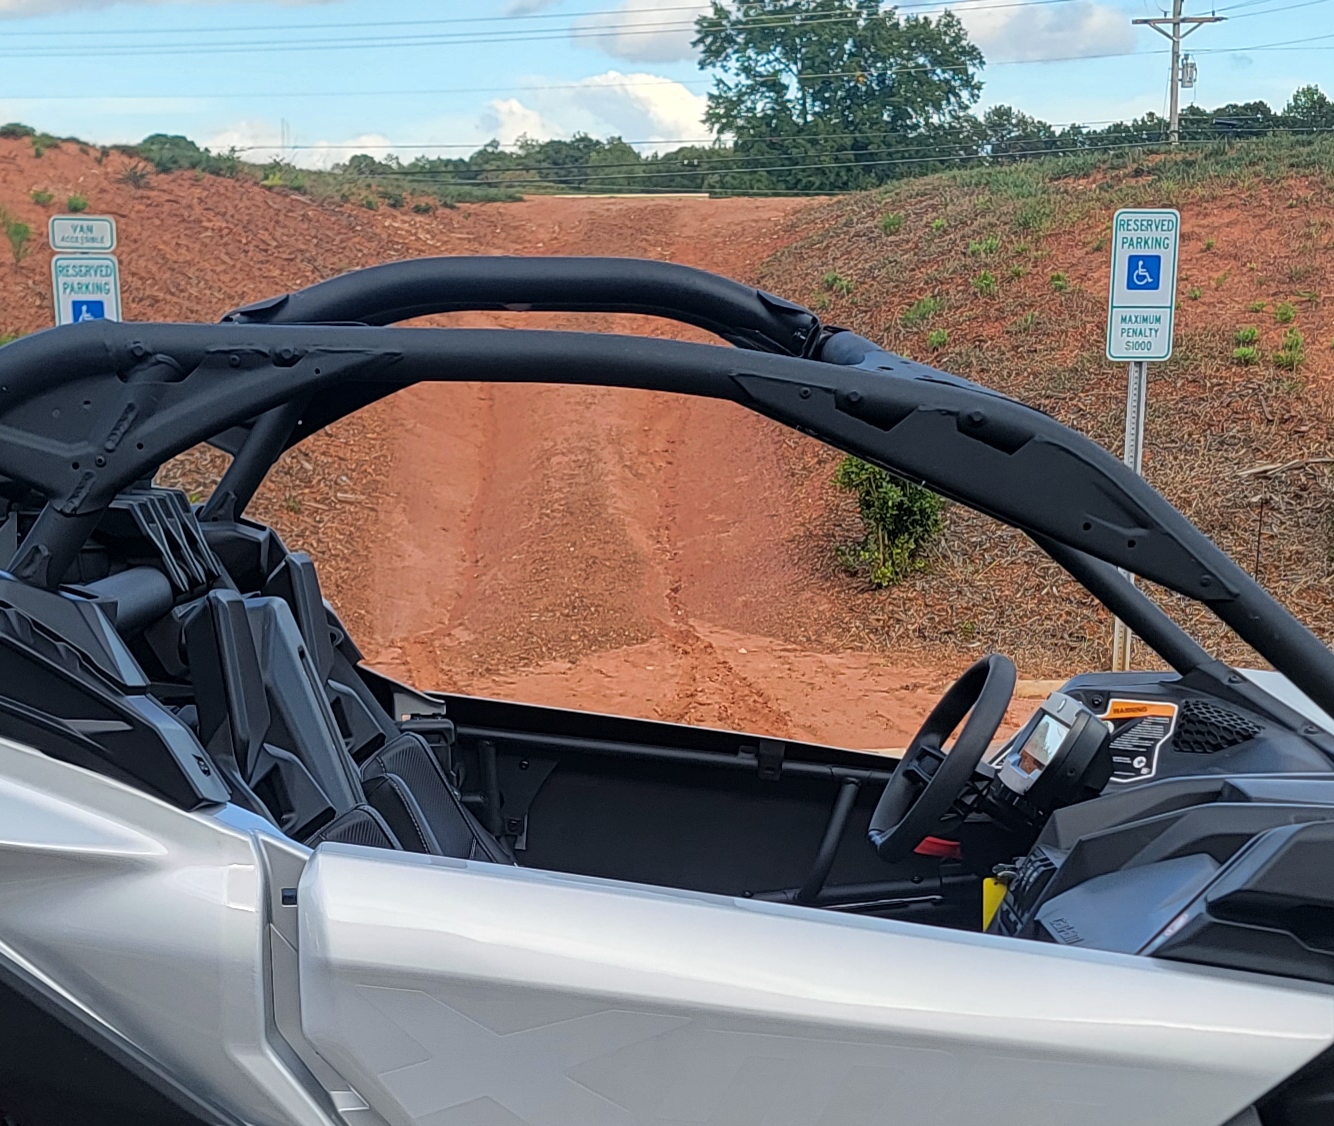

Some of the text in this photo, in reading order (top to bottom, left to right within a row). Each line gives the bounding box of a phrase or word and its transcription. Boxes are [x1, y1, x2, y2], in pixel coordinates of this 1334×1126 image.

[71, 224, 94, 234] VAN
[1119, 219, 1174, 232] RESERVED
[1121, 236, 1170, 250] PARKING
[58, 265, 113, 278] RESERVED
[63, 282, 111, 295] PARKING
[1120, 314, 1162, 325] MAXIMUM
[1120, 328, 1160, 338] PENALTY
